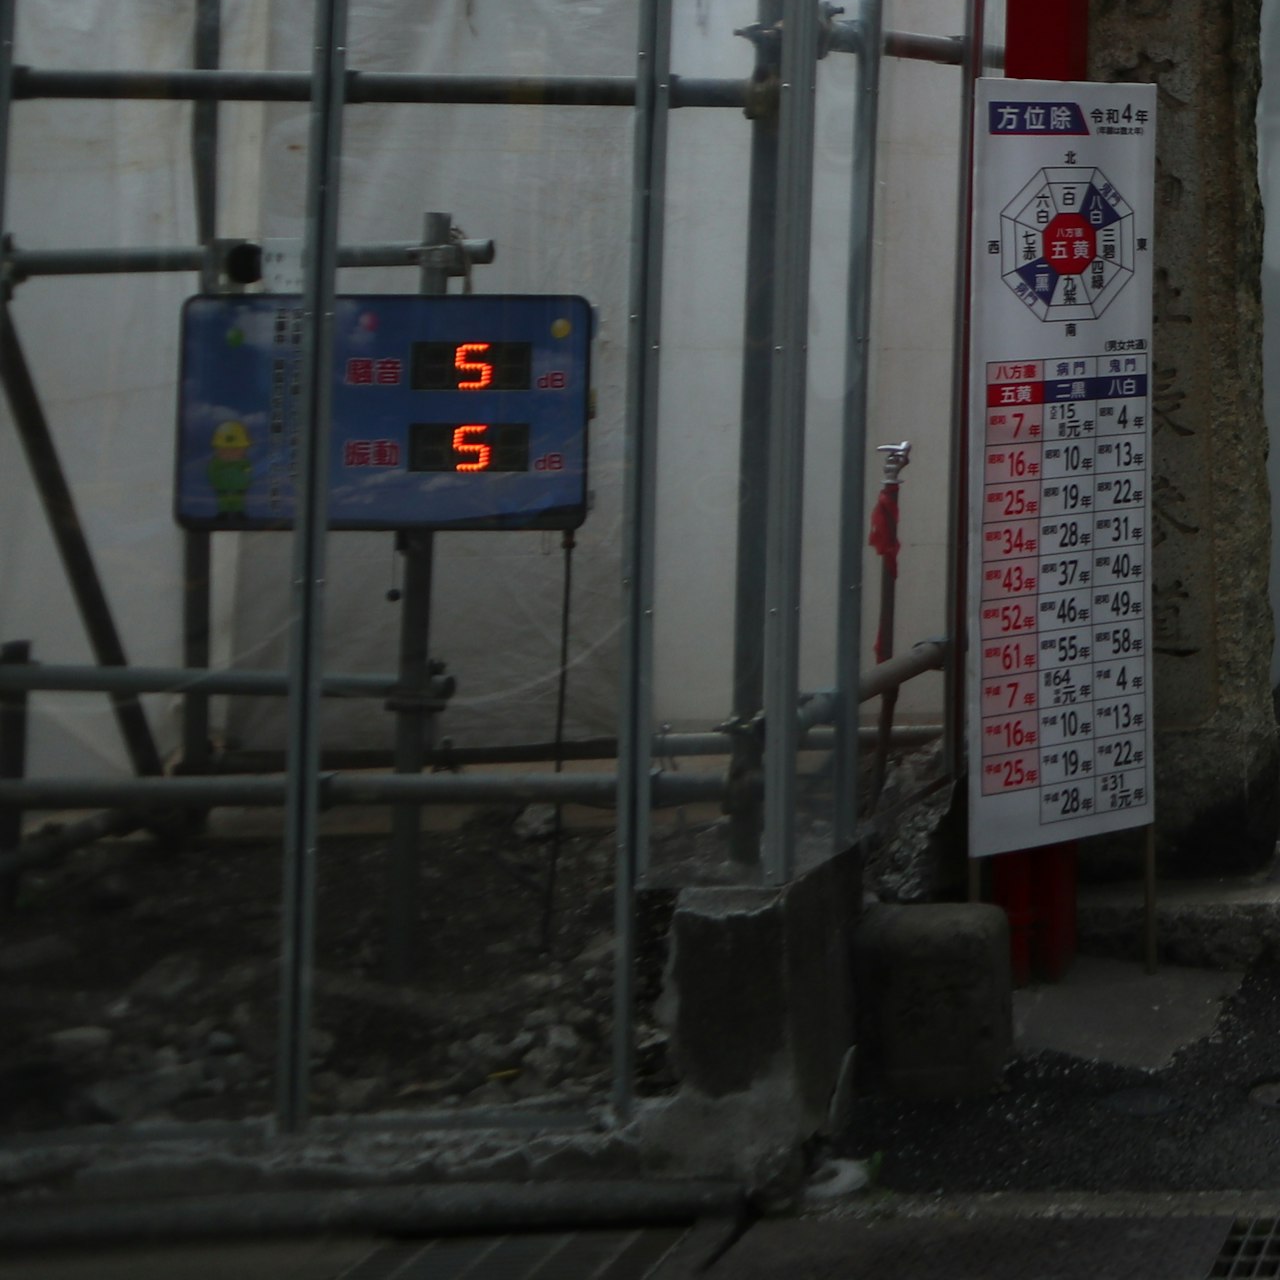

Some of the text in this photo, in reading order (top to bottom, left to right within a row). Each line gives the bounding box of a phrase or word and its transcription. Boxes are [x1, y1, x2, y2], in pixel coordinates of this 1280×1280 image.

[997, 106, 1072, 130] 方位除
[1091, 104, 1149, 125] 令和4年
[1064, 151, 1076, 164] 北
[988, 241, 1000, 254] 西
[1051, 241, 1089, 260] 五黄
[1137, 239, 1147, 251] 東
[1065, 324, 1076, 336] 南
[537, 372, 567, 390] dB
[1108, 379, 1136, 395] 八白
[1001, 387, 1032, 403] 五黄
[1056, 382, 1086, 399] 二黒
[535, 453, 564, 471] dB
